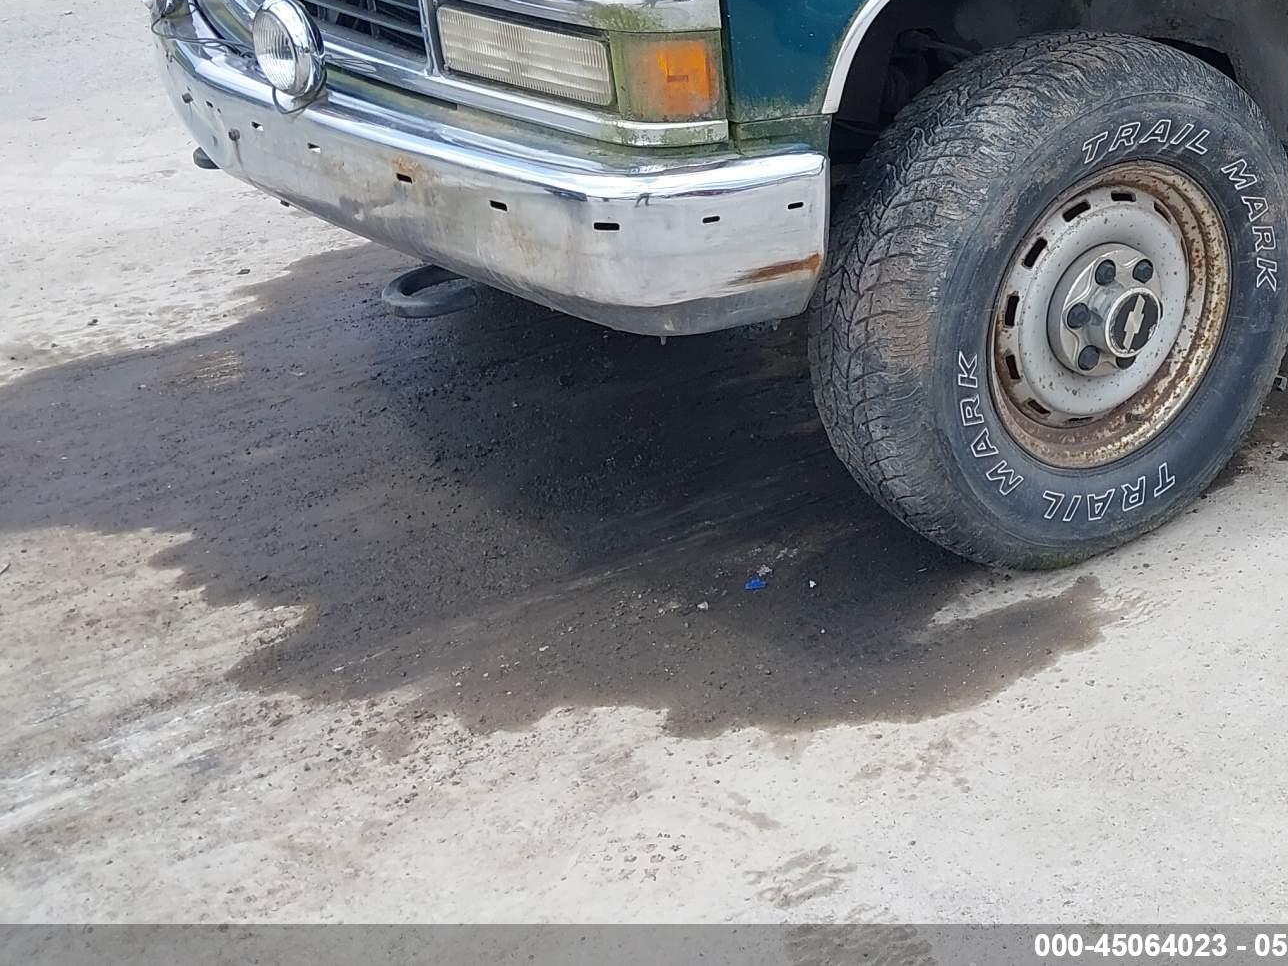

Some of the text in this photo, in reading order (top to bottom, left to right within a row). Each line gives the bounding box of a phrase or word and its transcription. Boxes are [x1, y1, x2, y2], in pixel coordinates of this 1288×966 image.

[1082, 119, 1279, 293] TRAIL MARK
[958, 350, 1176, 522] TRAIL MARK
